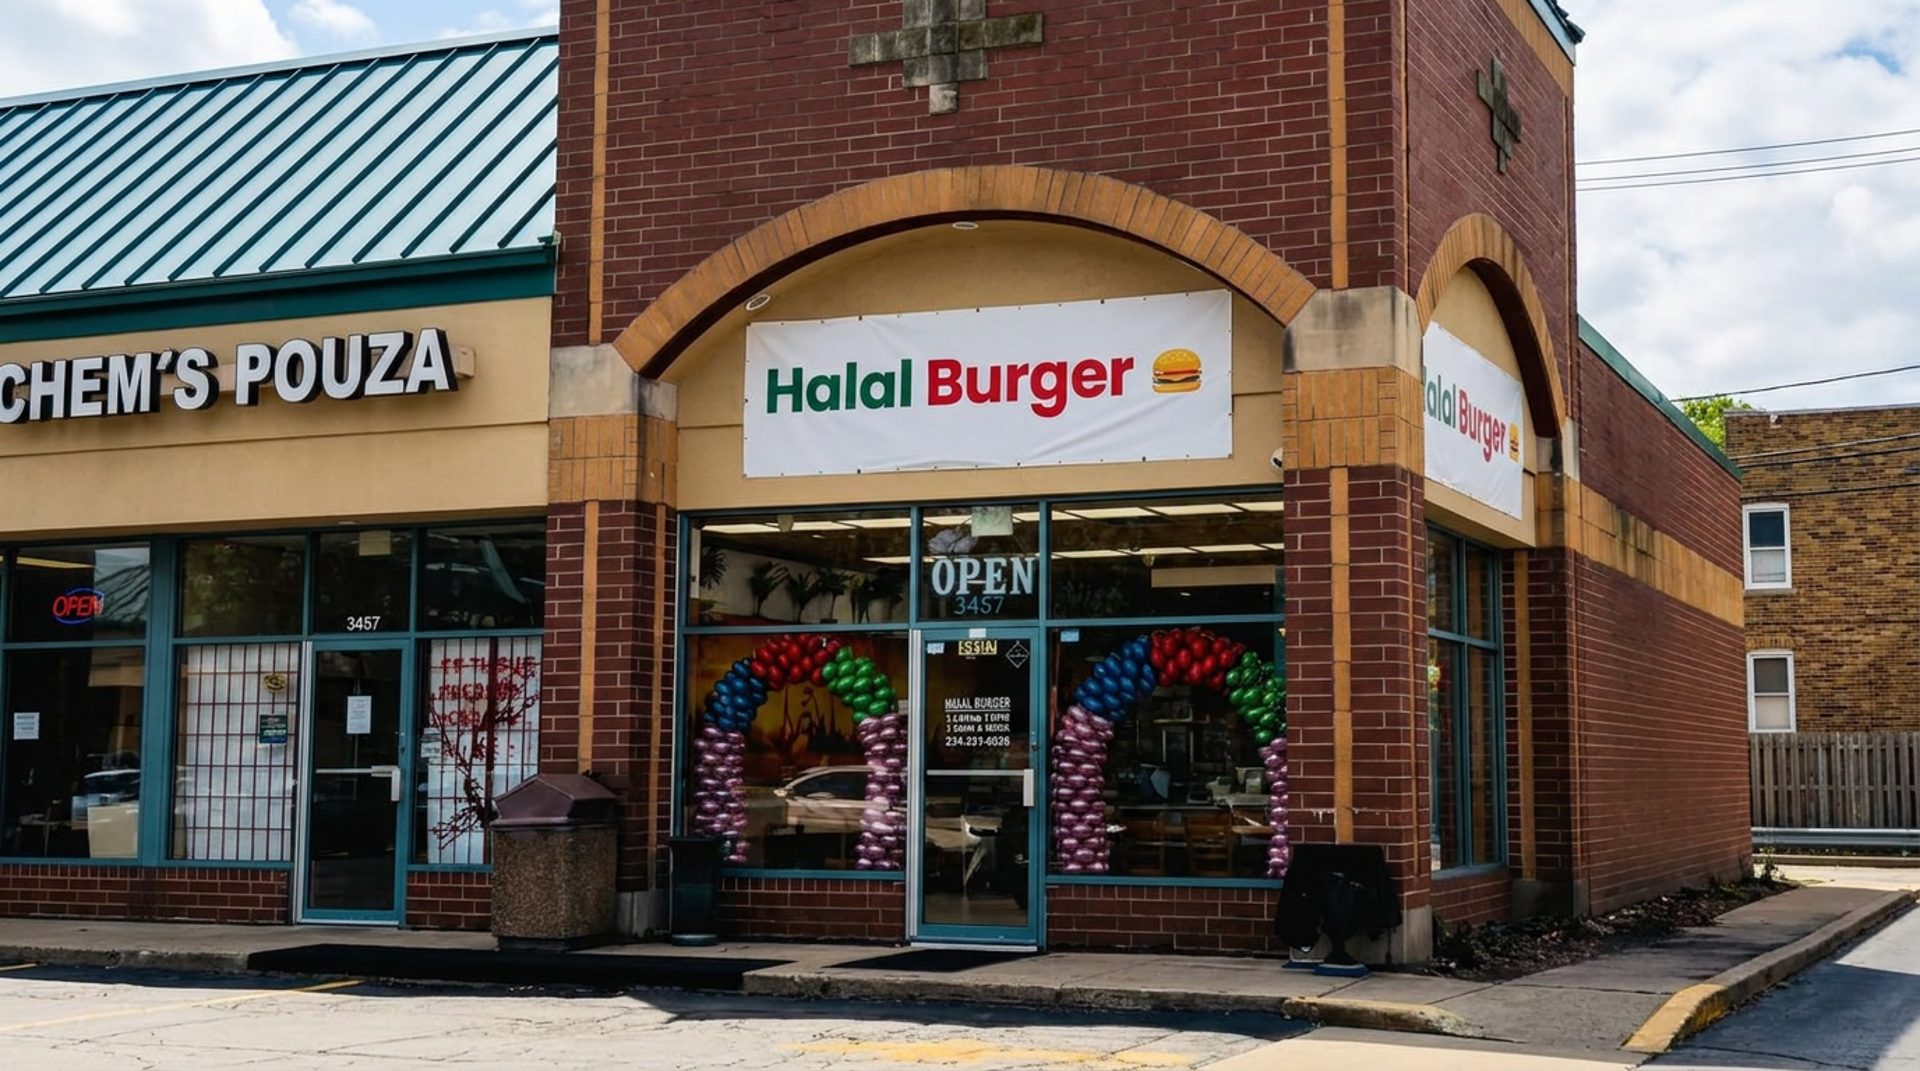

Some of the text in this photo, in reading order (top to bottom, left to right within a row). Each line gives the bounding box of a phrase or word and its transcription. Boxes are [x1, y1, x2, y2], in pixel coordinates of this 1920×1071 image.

[0, 328, 456, 424] CHEM'S POUZA
[766, 356, 1134, 418] Halal Burger
[1458, 388, 1506, 463] Burger
[931, 557, 1036, 595] OPEN
[53, 595, 104, 617] OPEN
[346, 615, 381, 631] 3457
[954, 597, 1006, 615] 3457
